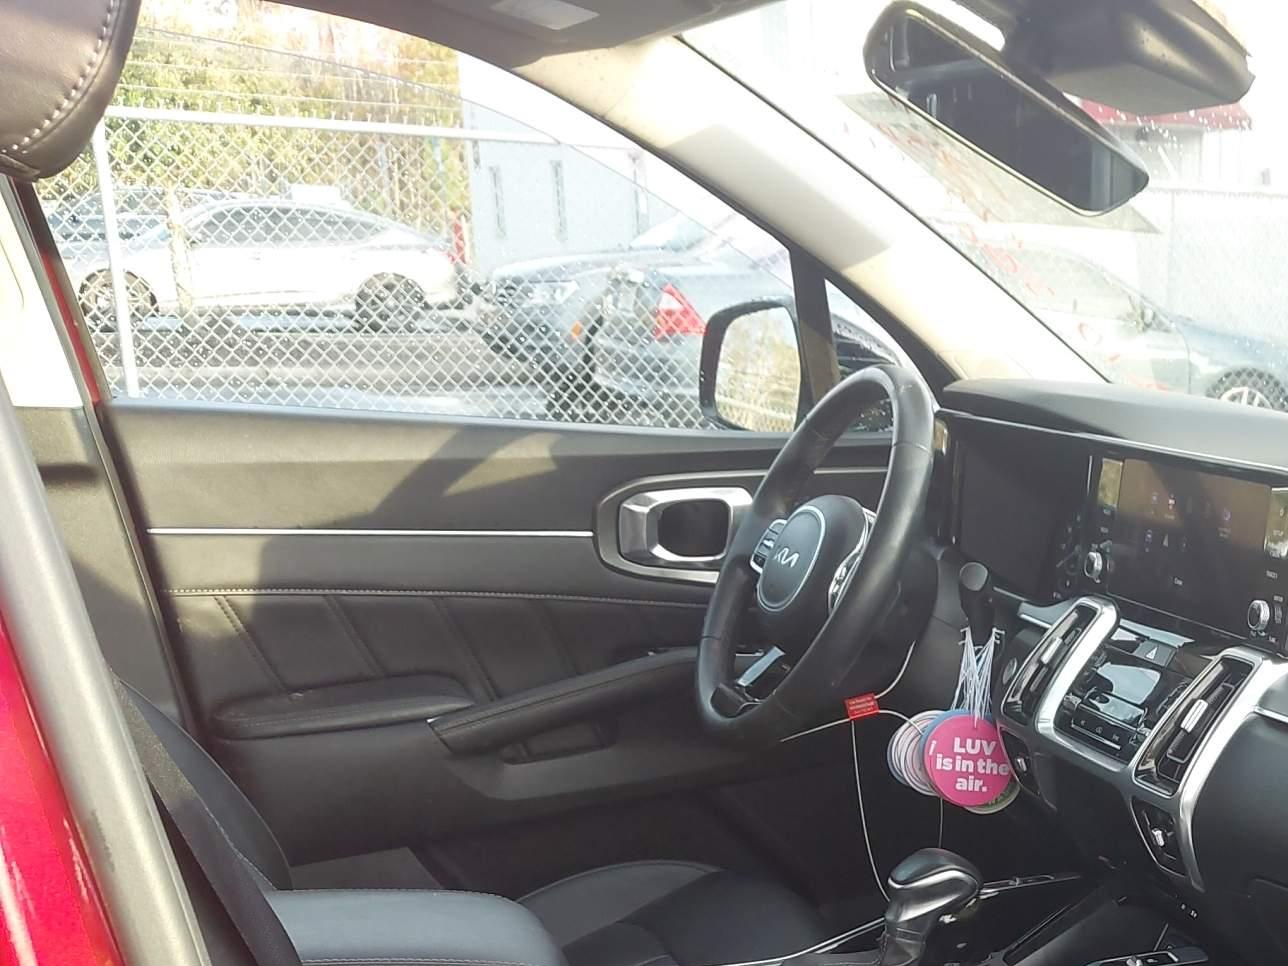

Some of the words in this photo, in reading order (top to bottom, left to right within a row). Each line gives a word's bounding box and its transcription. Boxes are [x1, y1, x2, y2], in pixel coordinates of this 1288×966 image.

[953, 737, 996, 756] LUV
[935, 753, 953, 770] is
[955, 755, 974, 773] in
[977, 759, 1009, 775] the
[956, 776, 987, 792] air.
